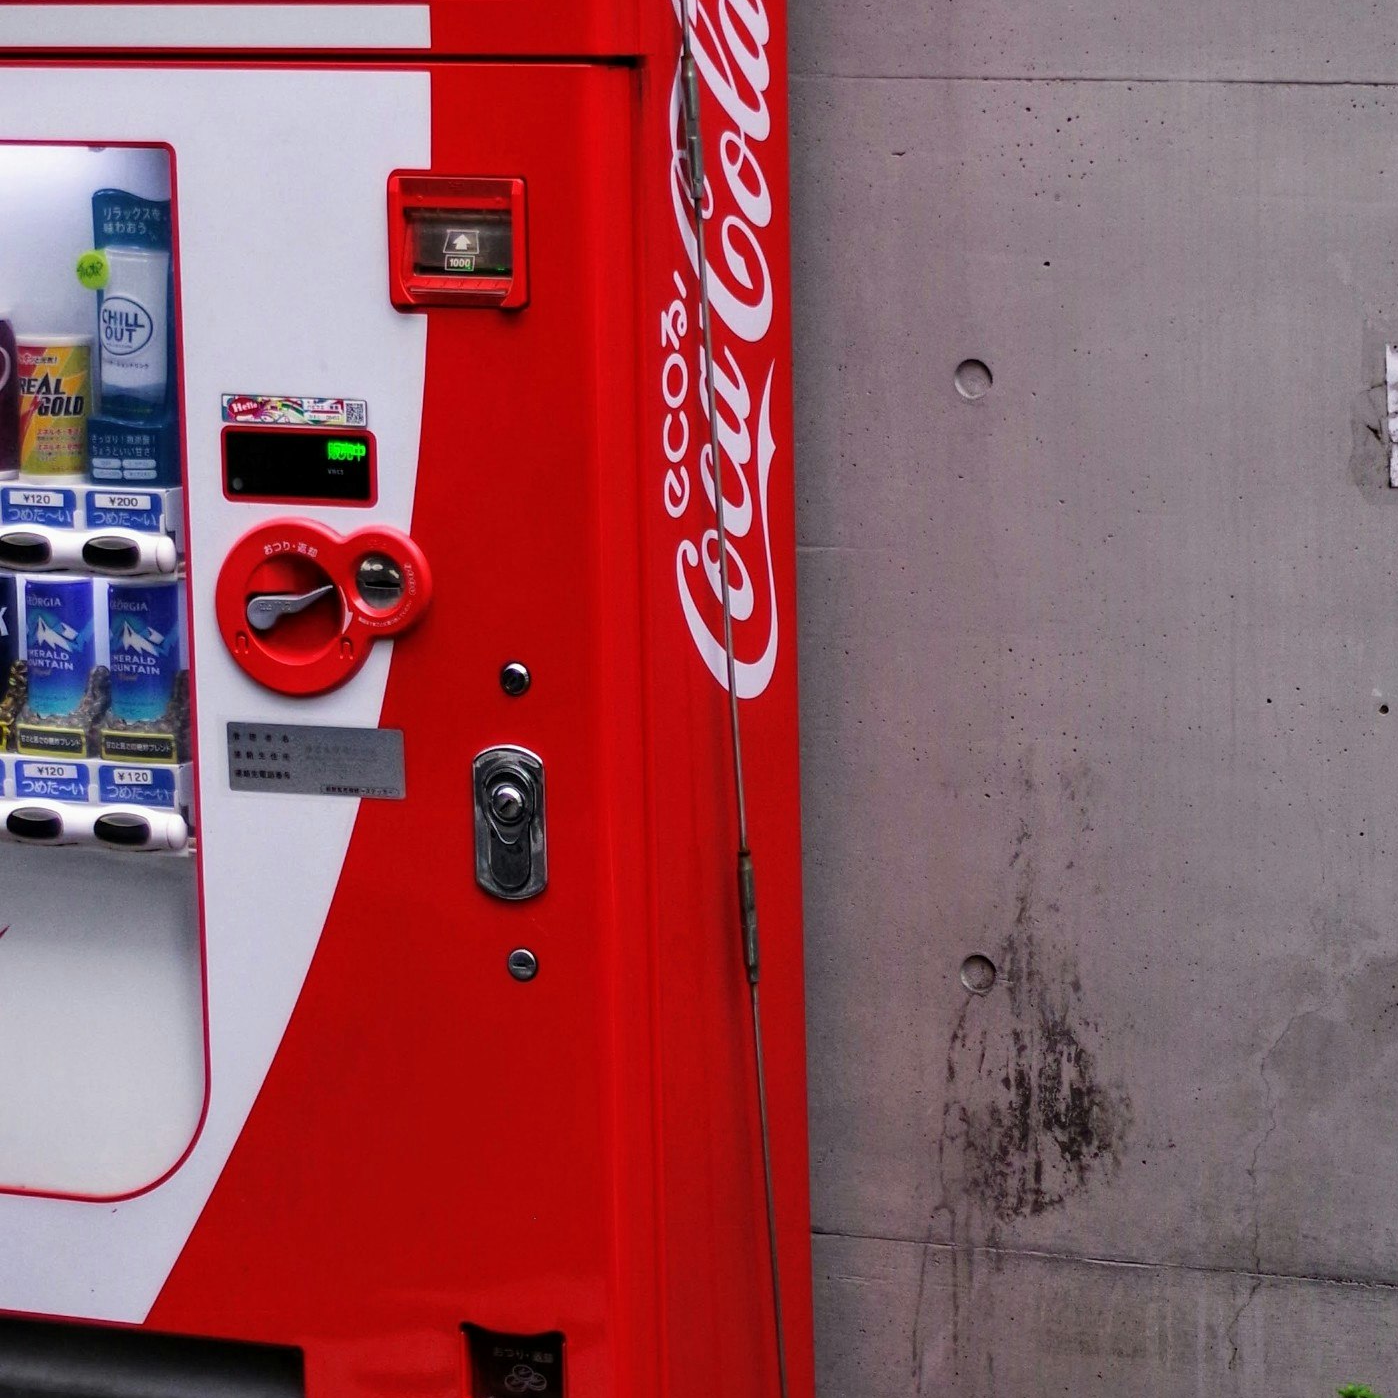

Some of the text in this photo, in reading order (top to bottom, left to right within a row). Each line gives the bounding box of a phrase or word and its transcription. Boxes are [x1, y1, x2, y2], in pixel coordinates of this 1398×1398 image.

[449, 258, 471, 268] 1000
[101, 308, 146, 329] CHILL
[104, 325, 137, 344] OUT
[20, 372, 66, 395] REAL
[37, 395, 84, 417] GOLD
[232, 401, 258, 413] Hello
[327, 441, 367, 462] 販売中
[23, 493, 51, 505] ¥120
[109, 496, 139, 508] ¥200
[37, 765, 65, 777] ¥120
